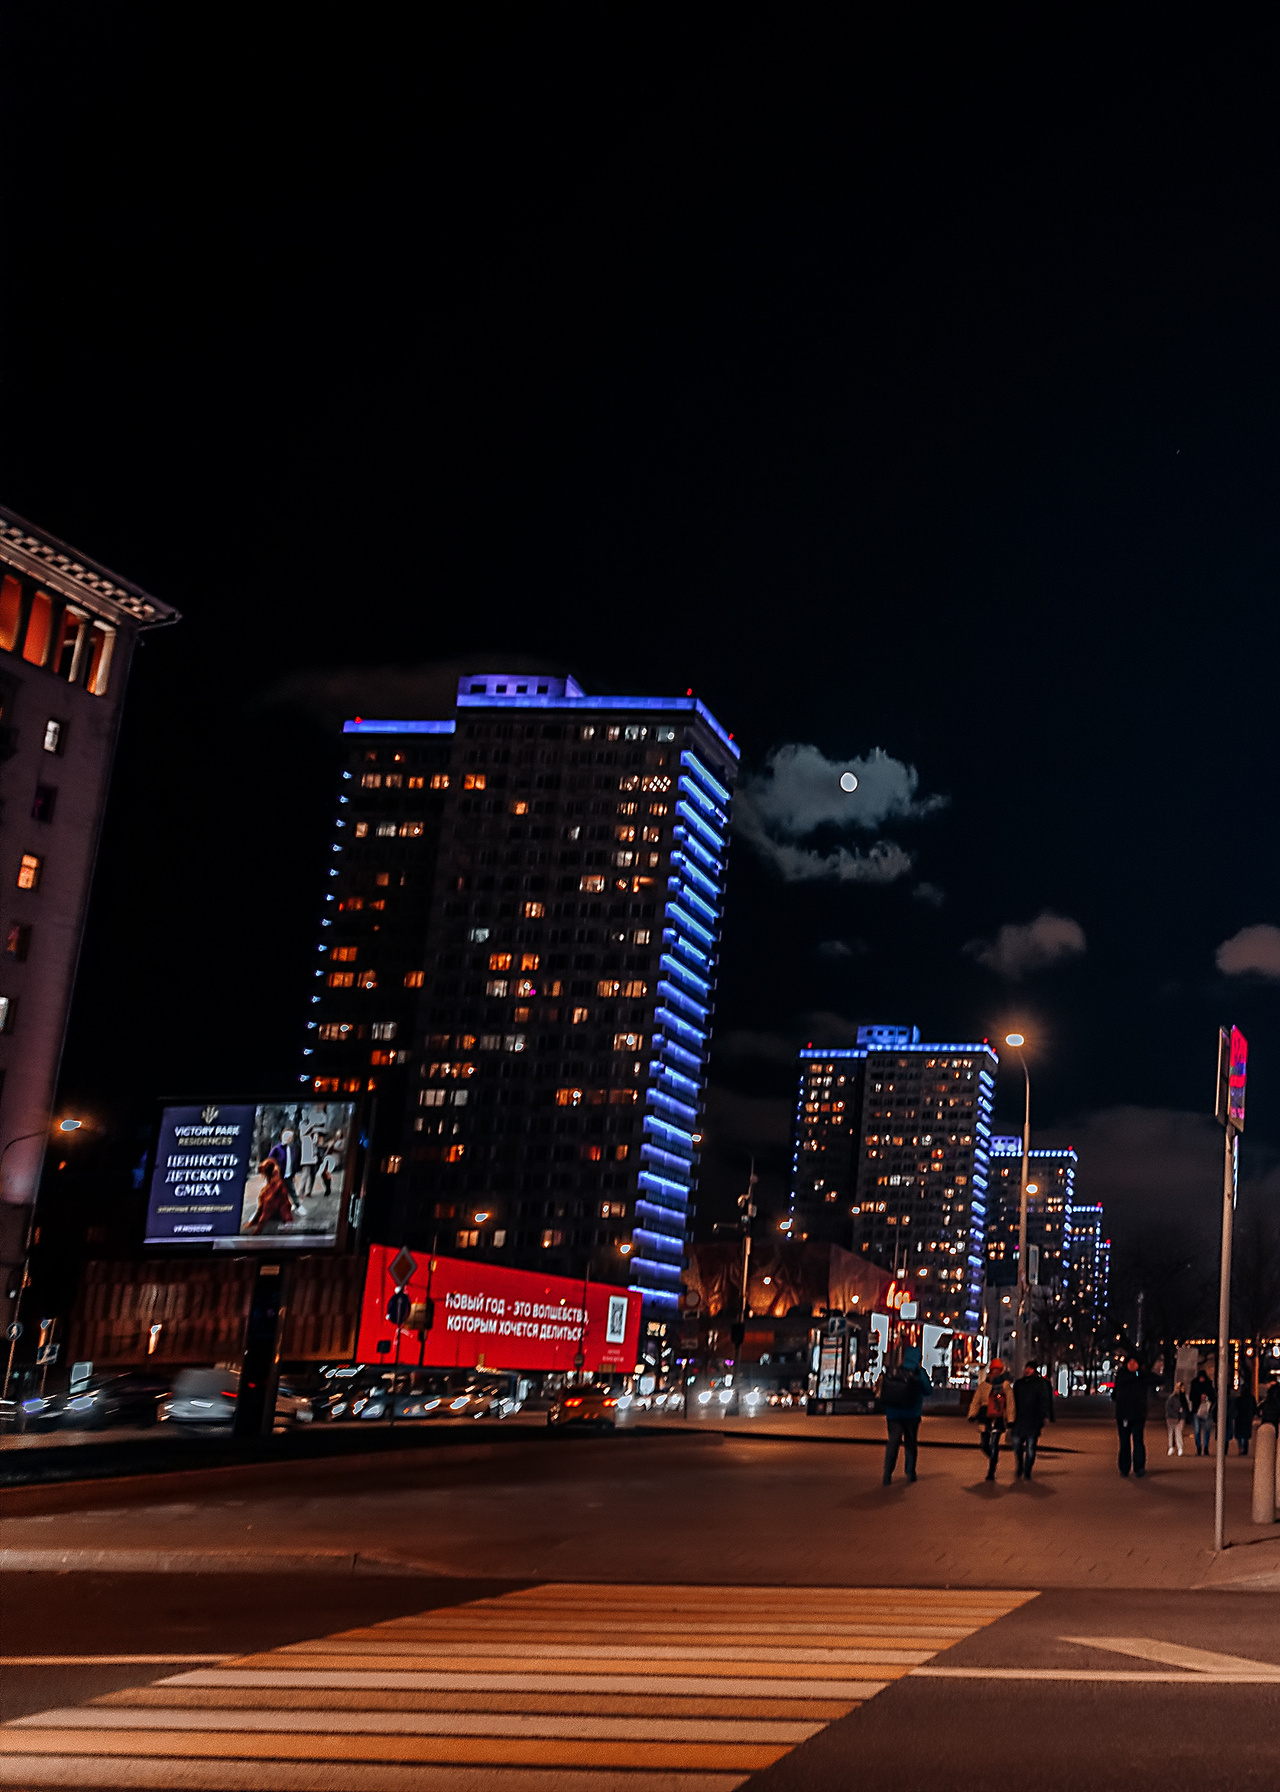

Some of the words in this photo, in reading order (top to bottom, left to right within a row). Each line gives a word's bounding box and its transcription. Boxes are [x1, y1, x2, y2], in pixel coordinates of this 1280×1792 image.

[174, 1126, 214, 1136] VICTORY
[215, 1125, 240, 1136] PARK
[178, 1137, 232, 1146] RESIDENCES
[167, 1154, 238, 1168] ЦЕННОСТЬ
[165, 1169, 234, 1183] ДЕТСКОГО
[174, 1184, 220, 1196] СМЕХА
[445, 1292, 484, 1311] НОВЫЙ
[485, 1297, 505, 1317] ГОД
[513, 1300, 531, 1317] ЭТО
[447, 1315, 498, 1335] КОТОРЫМ
[498, 1320, 538, 1337] ХОЧЕТСЯ
